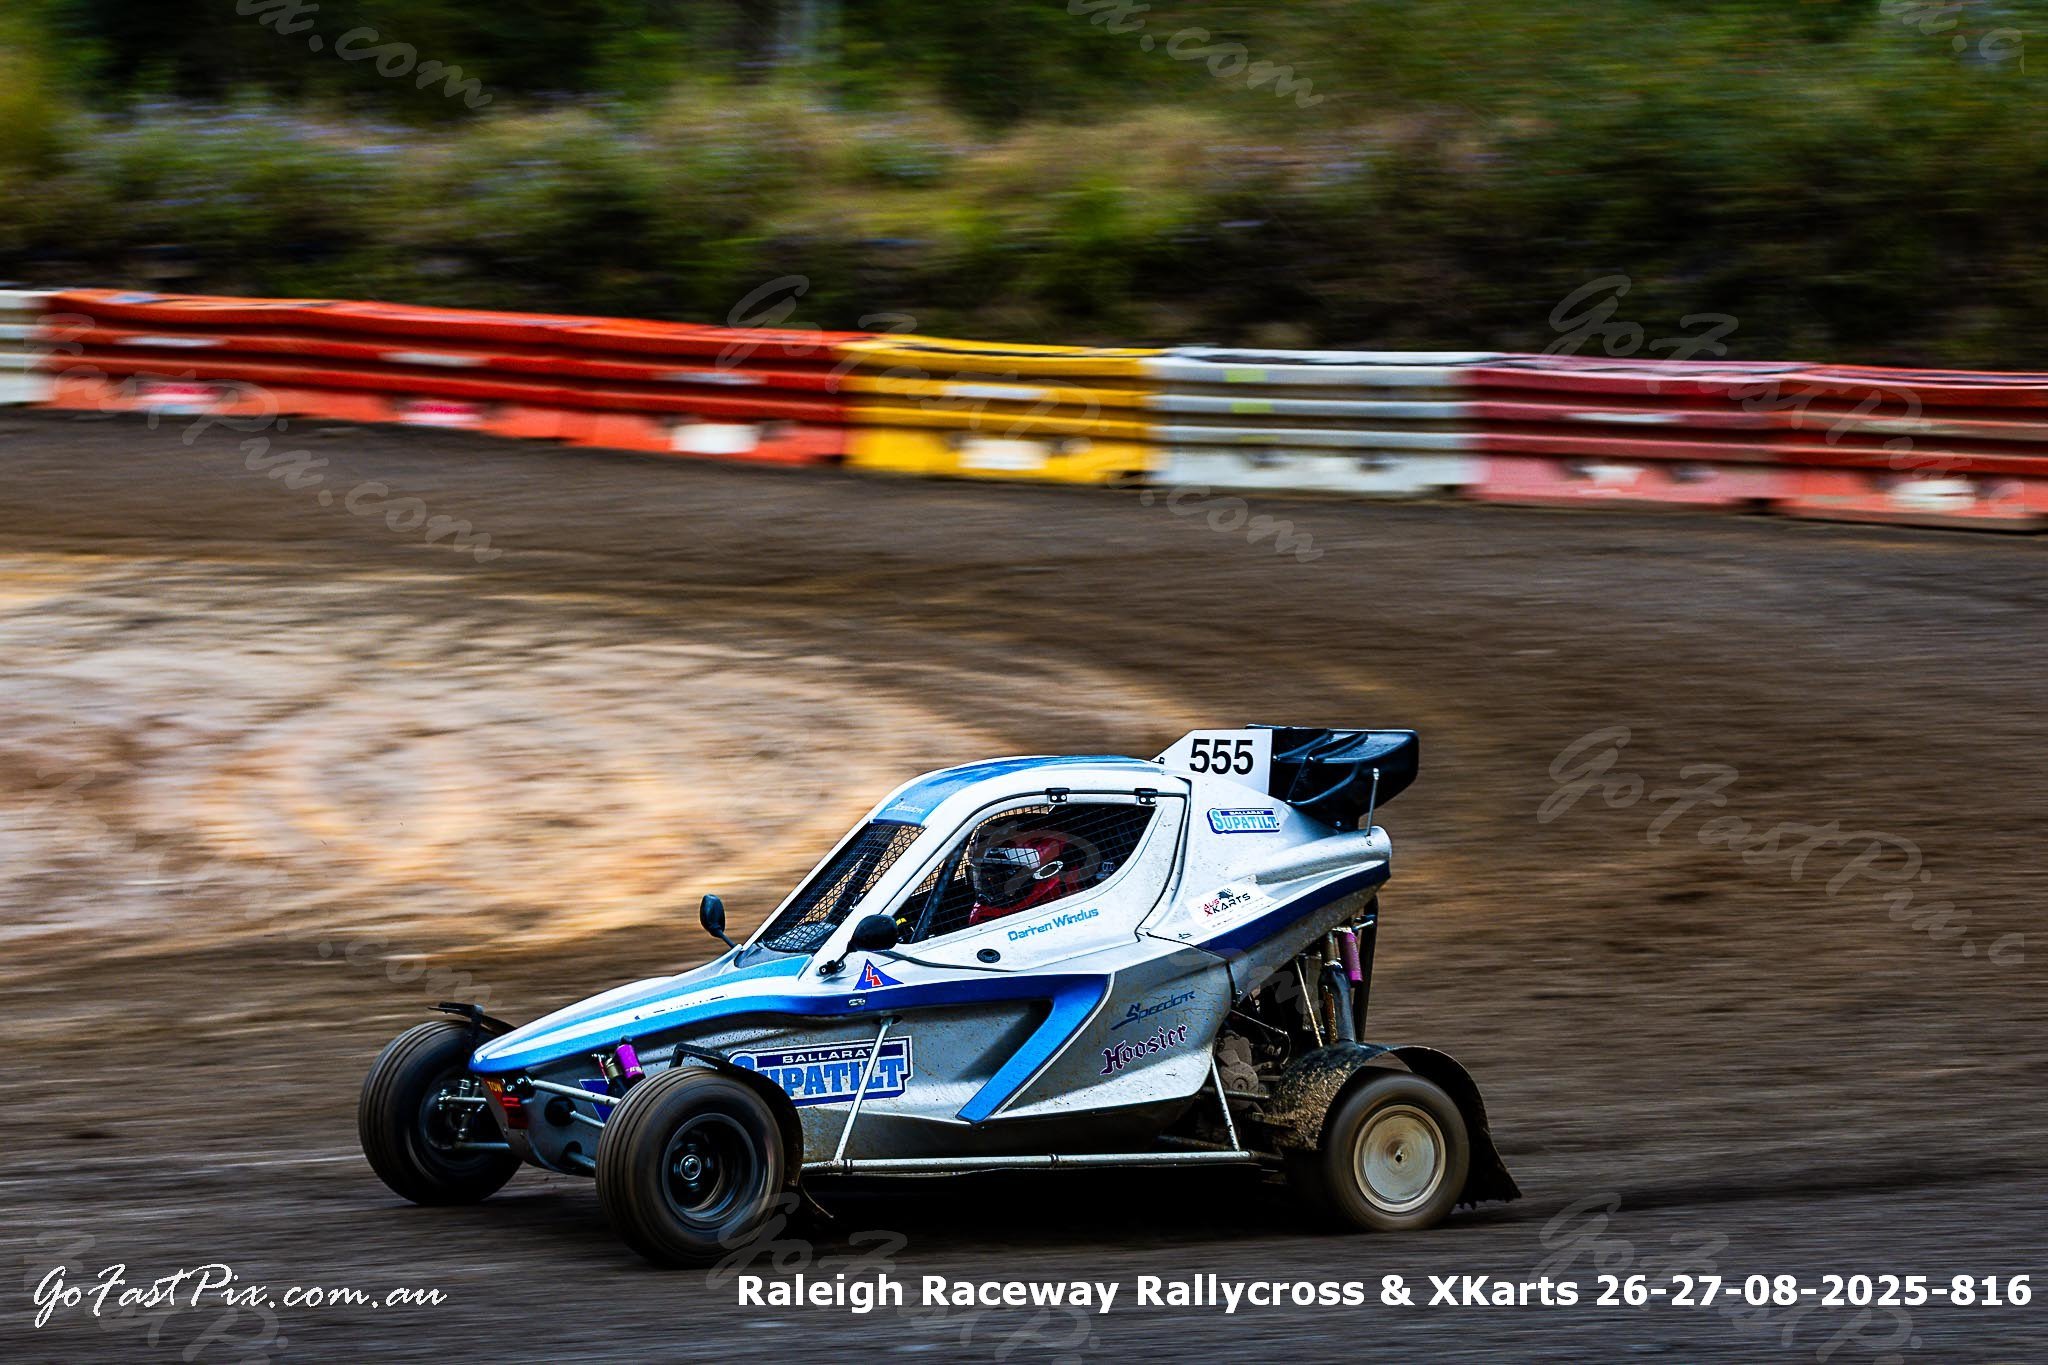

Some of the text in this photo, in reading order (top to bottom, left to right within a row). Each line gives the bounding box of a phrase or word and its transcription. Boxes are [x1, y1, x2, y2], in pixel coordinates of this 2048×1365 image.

[1189, 738, 1254, 775] 555
[1211, 810, 1277, 830] SUPATILT
[1007, 908, 1099, 941] Darren Windus
[1100, 1024, 1187, 1075] Hoosier
